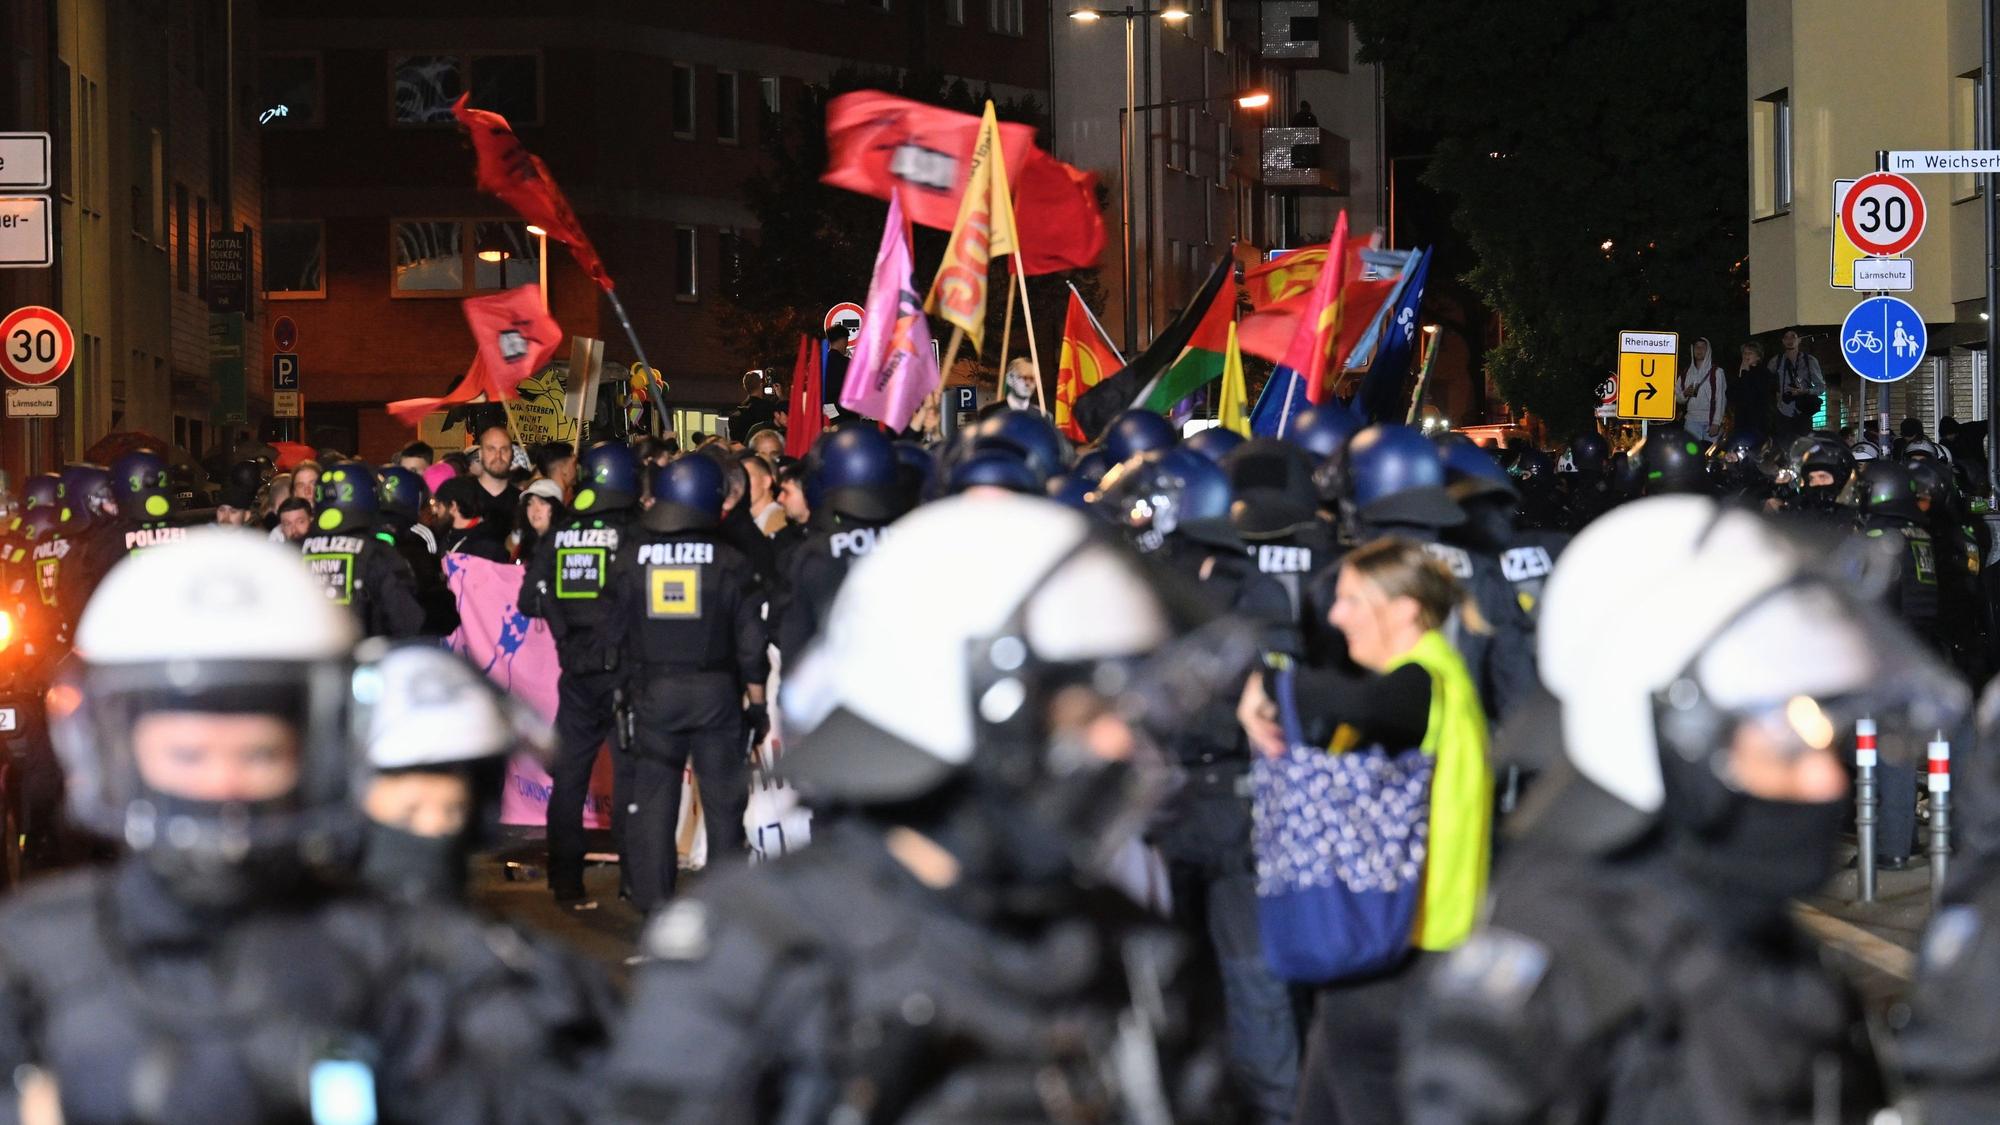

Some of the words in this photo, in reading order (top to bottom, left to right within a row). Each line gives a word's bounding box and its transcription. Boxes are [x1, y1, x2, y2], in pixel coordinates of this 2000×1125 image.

[1897, 155, 1915, 168] Im
[0, 214, 29, 228] er-
[1860, 196, 1906, 233] 30
[210, 239, 242, 248] DIGITAL
[210, 260, 242, 271] SOZIAL
[1859, 271, 1906, 280] Lärmschutz
[12, 329, 56, 363] 30
[1625, 337, 1672, 347] Rheinaustr.
[279, 358, 293, 385] P
[1640, 358, 1655, 378] U
[12, 399, 53, 408] Lärmschutz
[960, 388, 973, 408] P
[526, 404, 555, 415] STERBEN
[129, 474, 142, 493] 3
[158, 471, 167, 488] 2
[341, 483, 354, 503] 2
[125, 528, 187, 549] POLIZEI
[302, 536, 364, 554] POLIZEI
[566, 554, 594, 568] NRW
[637, 542, 714, 565] POLIZEI
[312, 559, 342, 573] NRW
